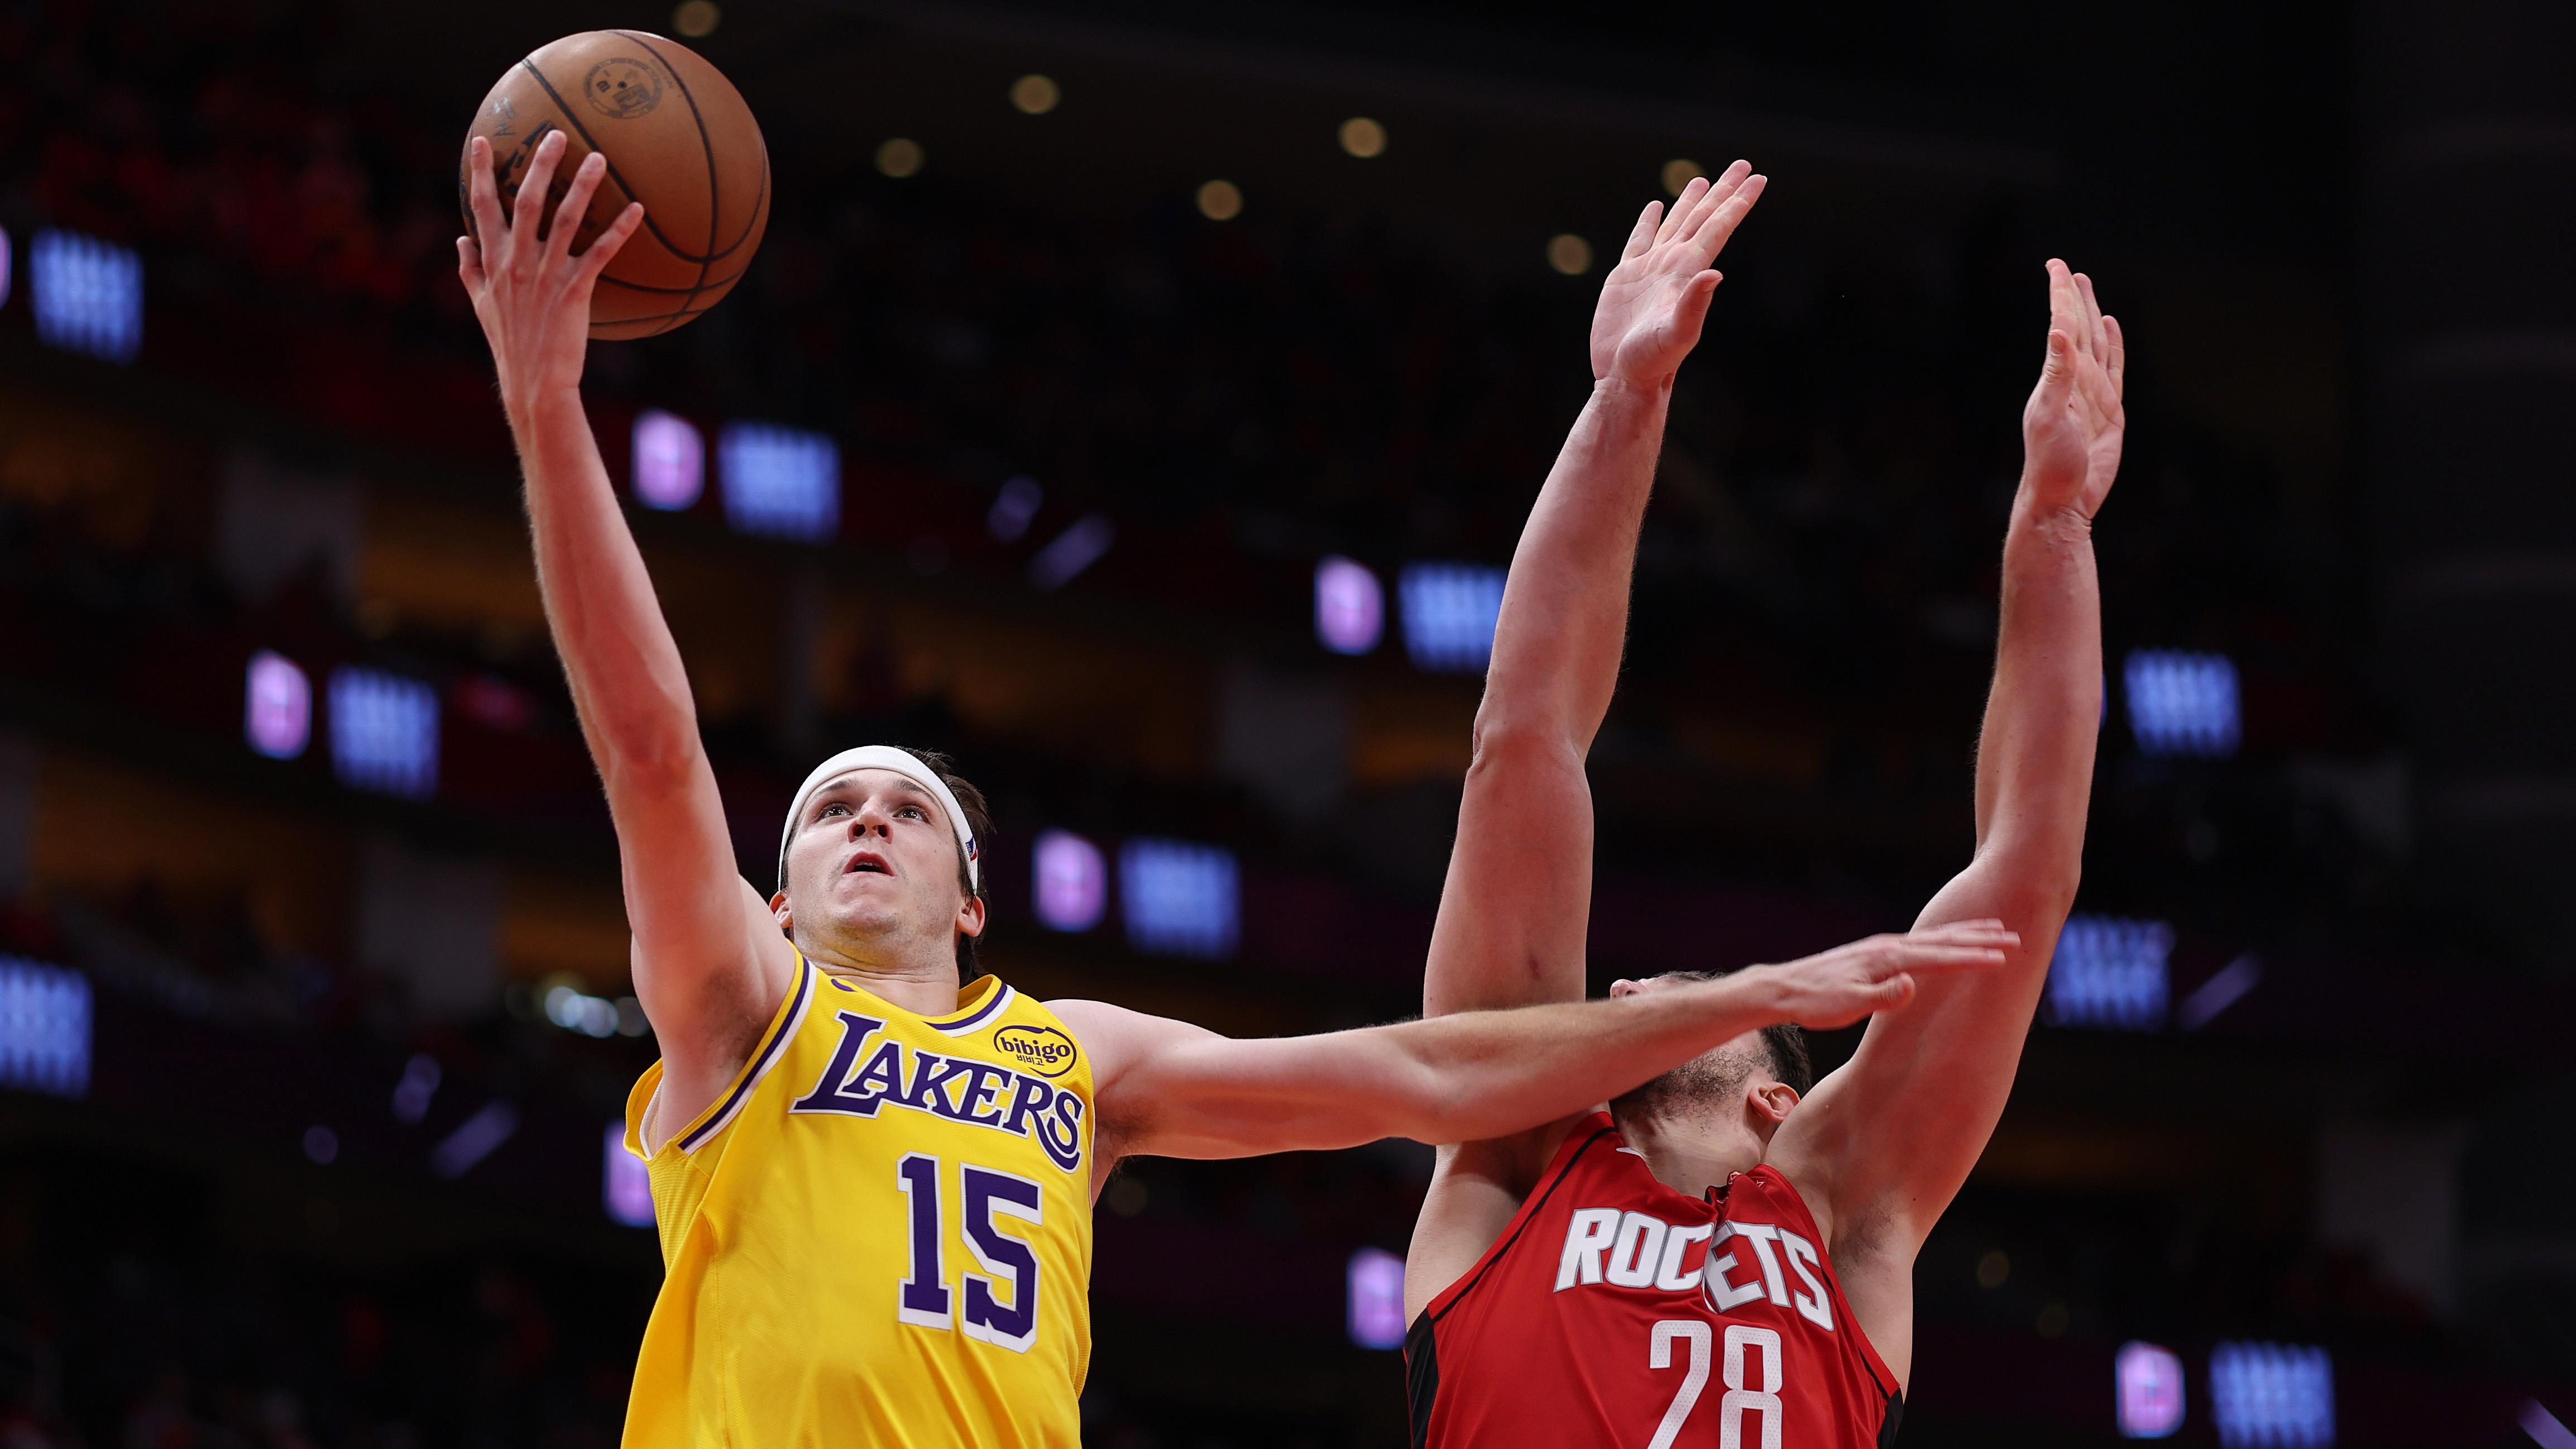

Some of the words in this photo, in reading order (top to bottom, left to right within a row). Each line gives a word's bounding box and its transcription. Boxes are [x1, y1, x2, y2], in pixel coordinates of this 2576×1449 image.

[788, 1008, 1085, 1174] LAKERS
[1000, 1037, 1070, 1063] bibigo
[1016, 1054, 1045, 1066] 비비고
[897, 1150, 1043, 1354] 15
[1553, 1207, 1835, 1332] ROCETS
[1646, 1320, 1783, 1449] 28
